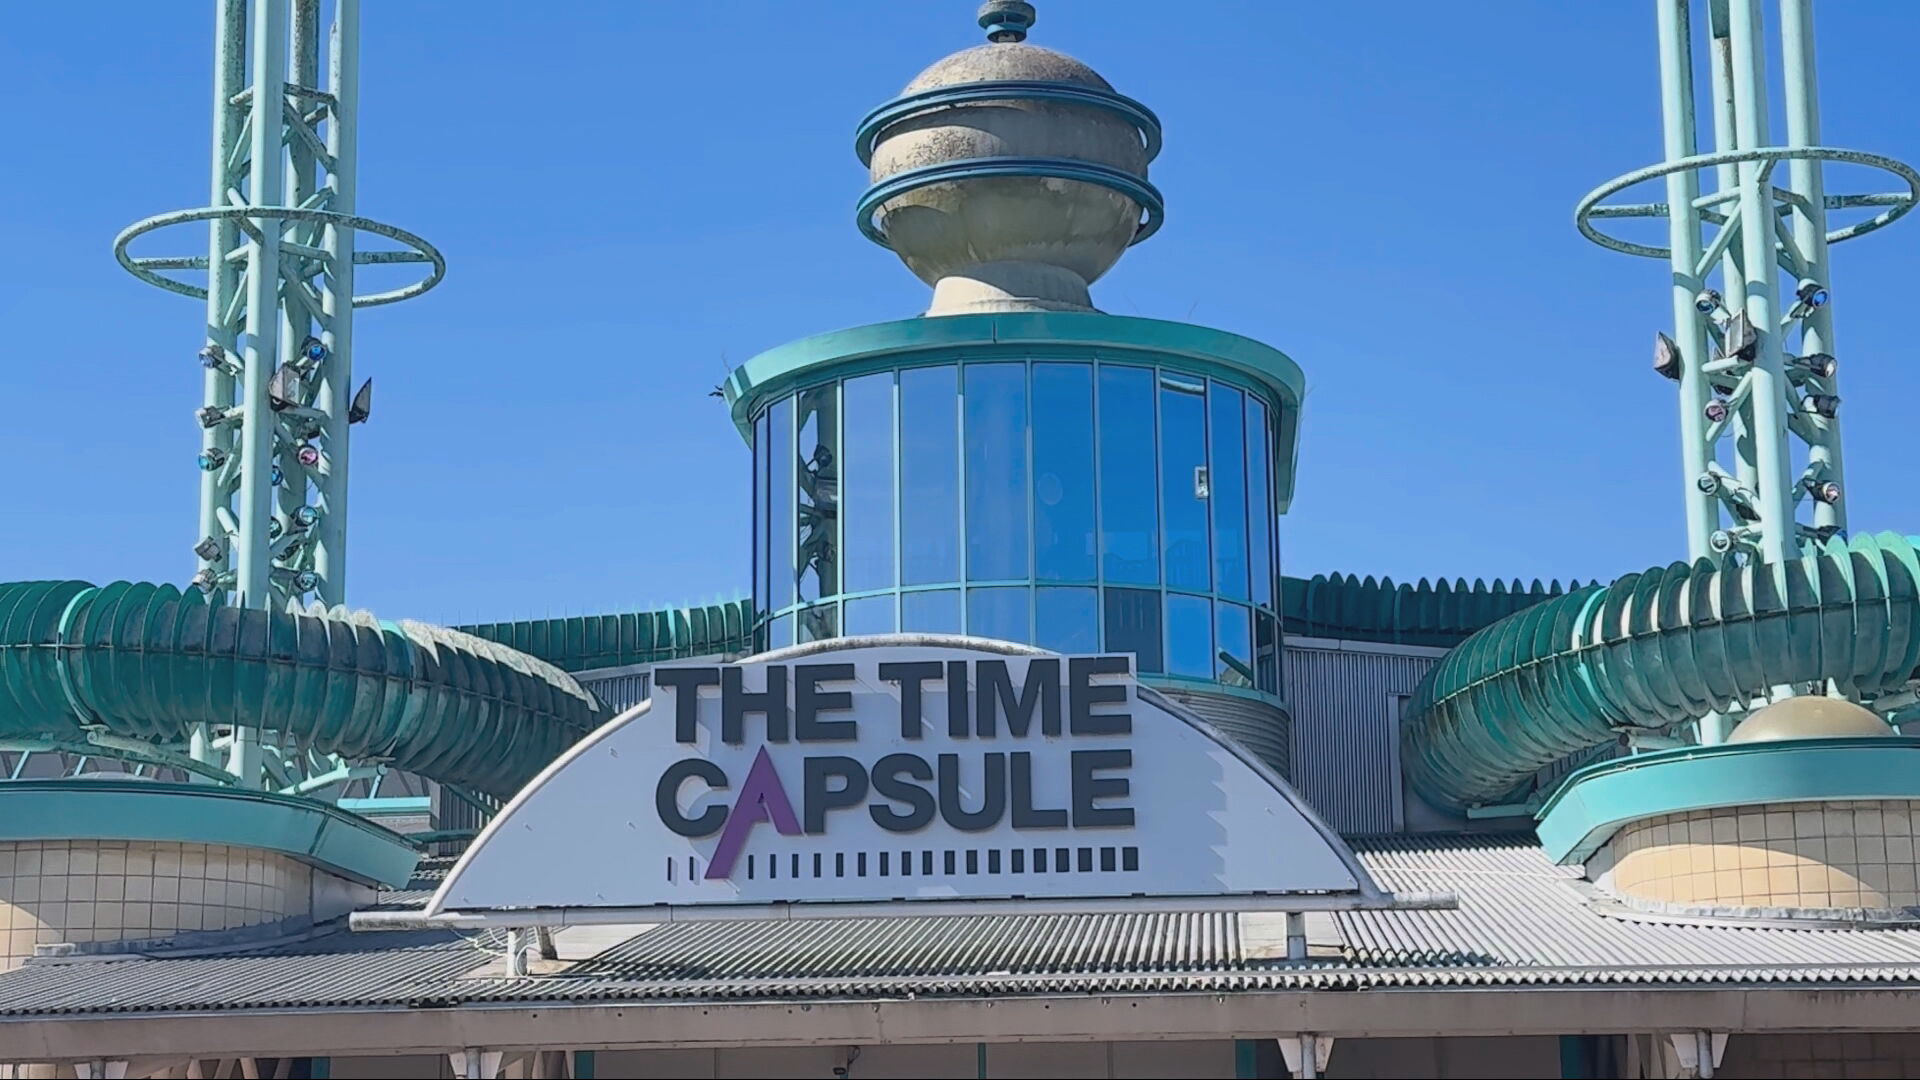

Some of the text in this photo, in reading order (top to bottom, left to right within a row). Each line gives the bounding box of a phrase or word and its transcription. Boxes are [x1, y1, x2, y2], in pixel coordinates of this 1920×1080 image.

[654, 657, 1133, 743] THE TIME
[655, 744, 1136, 879] CAPSULE
